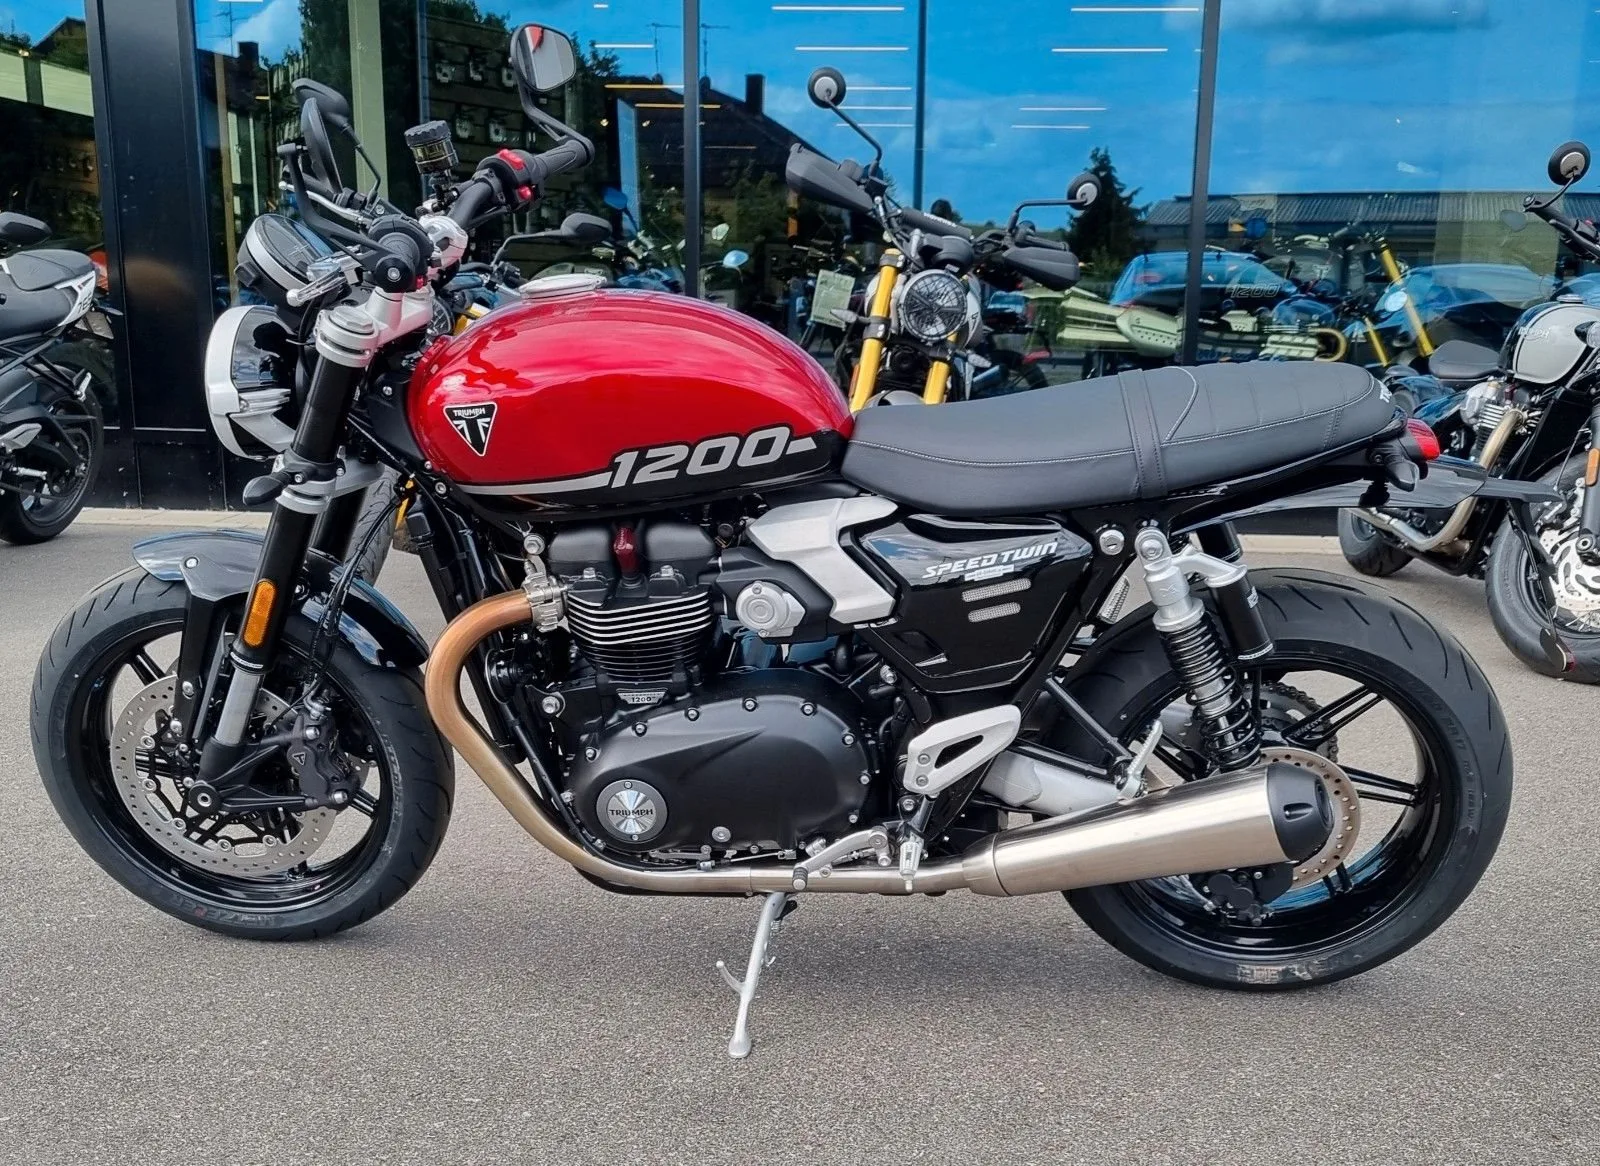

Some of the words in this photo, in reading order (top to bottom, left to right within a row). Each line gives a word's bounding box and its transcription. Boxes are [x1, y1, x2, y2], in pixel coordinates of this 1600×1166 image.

[452, 407, 486, 417] TRIUMPH
[611, 426, 791, 488] 1200
[921, 553, 999, 579] SPEED
[1001, 541, 1059, 562] TWIN
[608, 808, 653, 817] TRIUMPH
